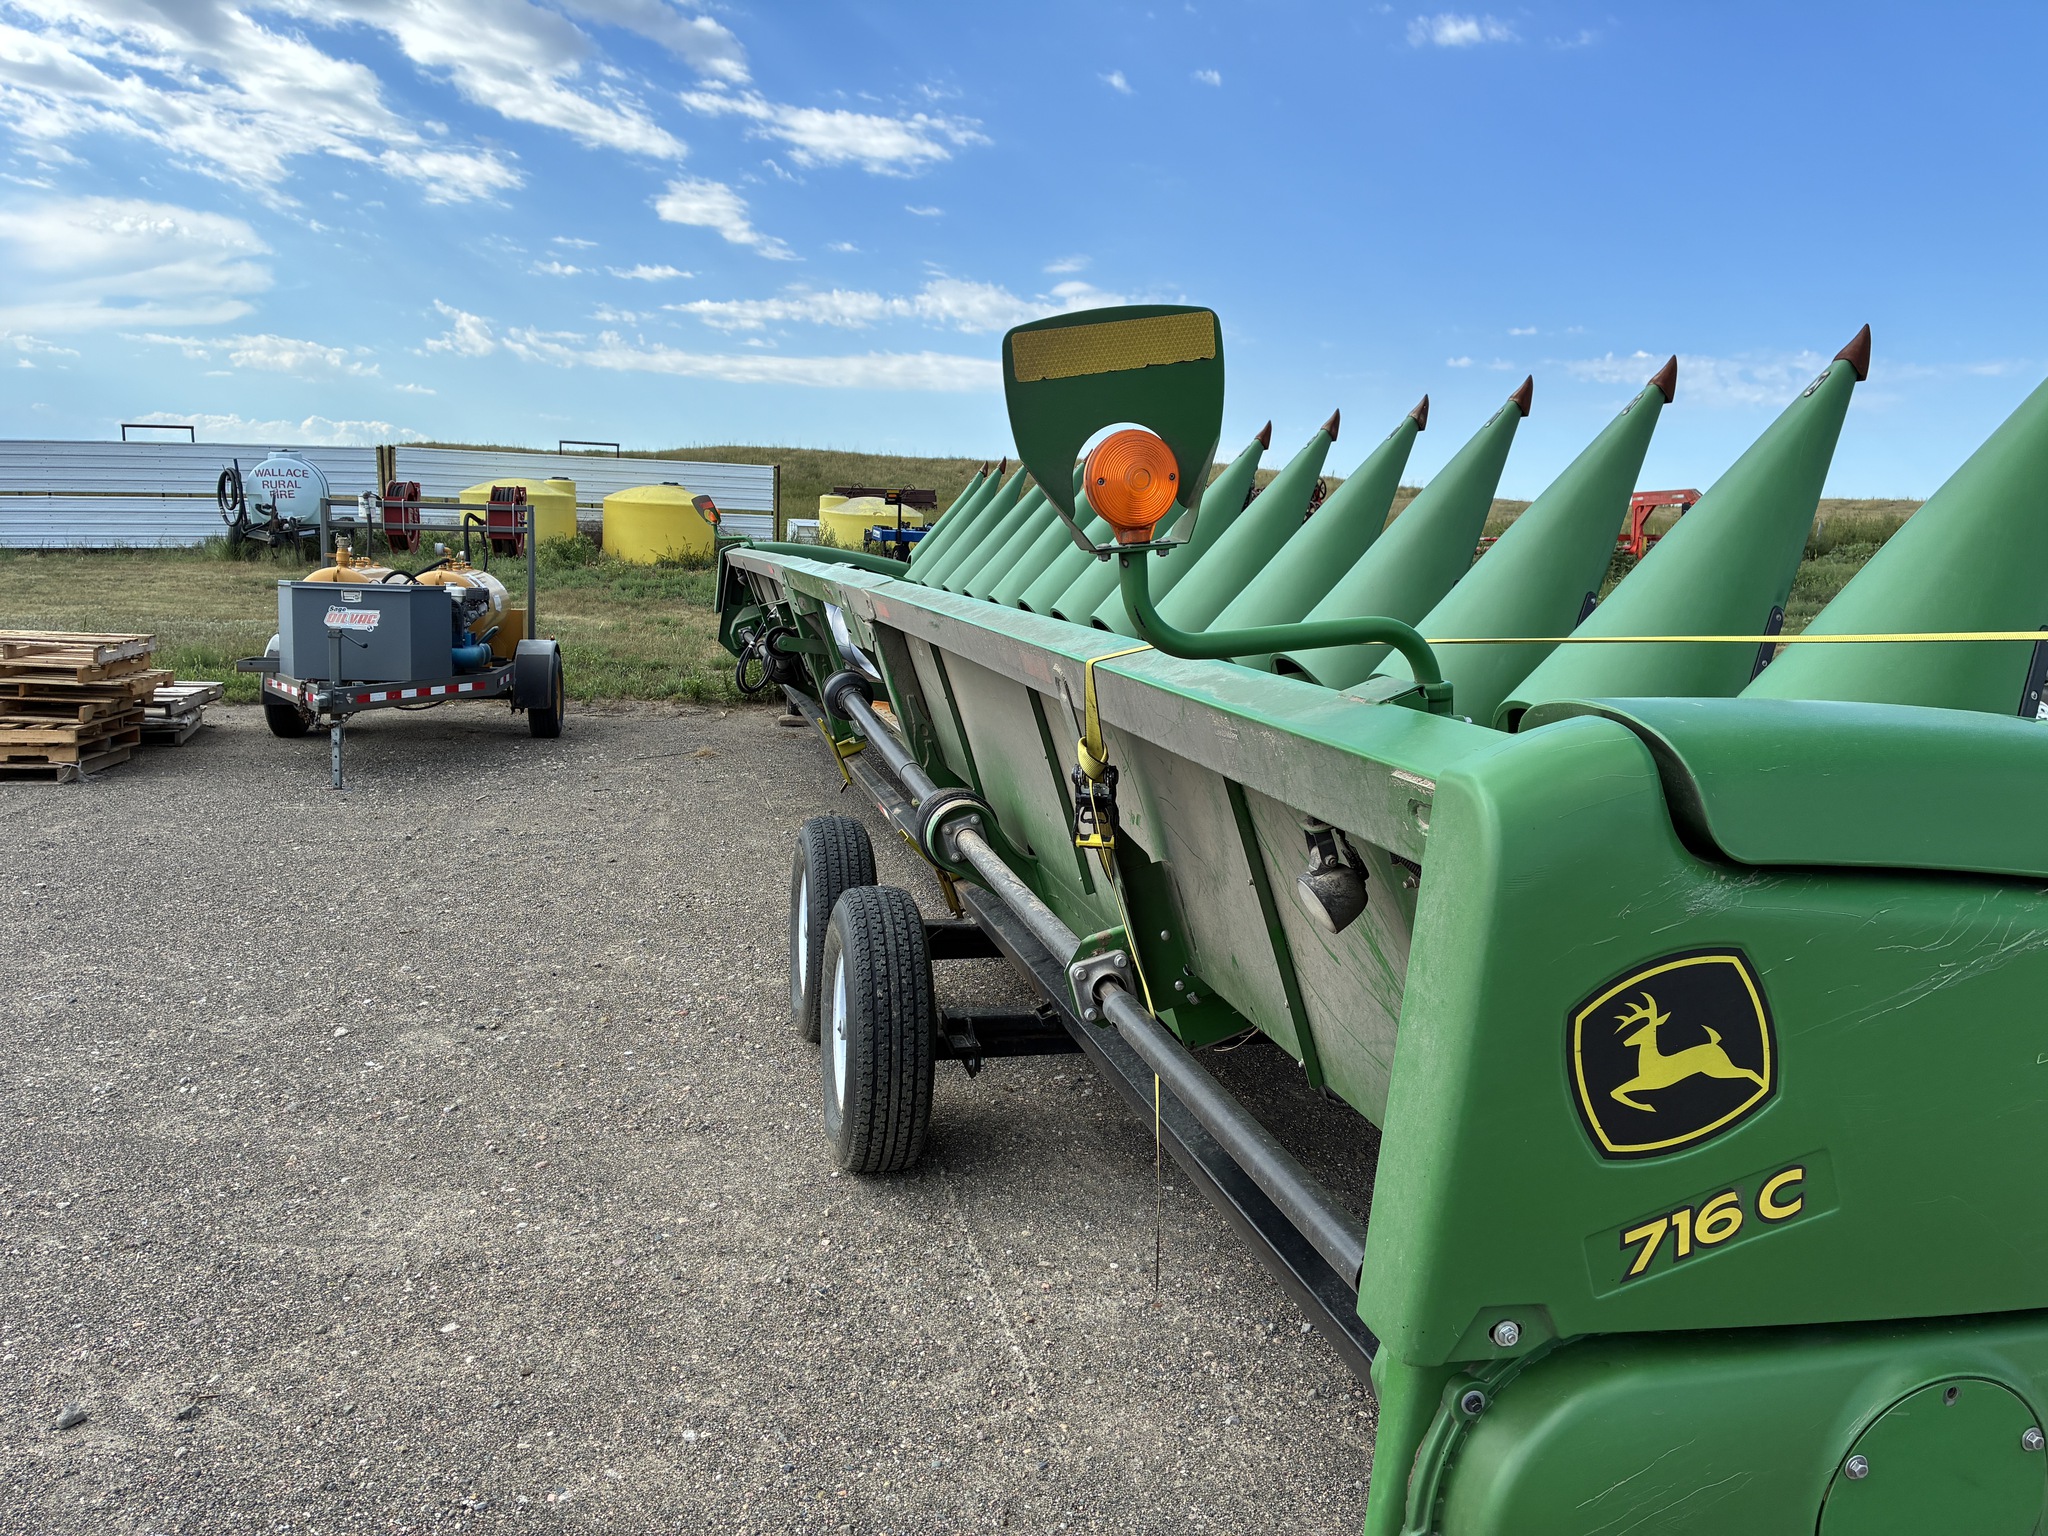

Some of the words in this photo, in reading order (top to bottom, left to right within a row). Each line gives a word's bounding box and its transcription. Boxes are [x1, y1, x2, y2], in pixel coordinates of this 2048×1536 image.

[254, 468, 310, 478] WALLACE
[262, 480, 301, 489] RURAL
[269, 489, 296, 499] FIRE
[1620, 1187, 1743, 1284] 716
[1755, 1164, 1806, 1224] C
